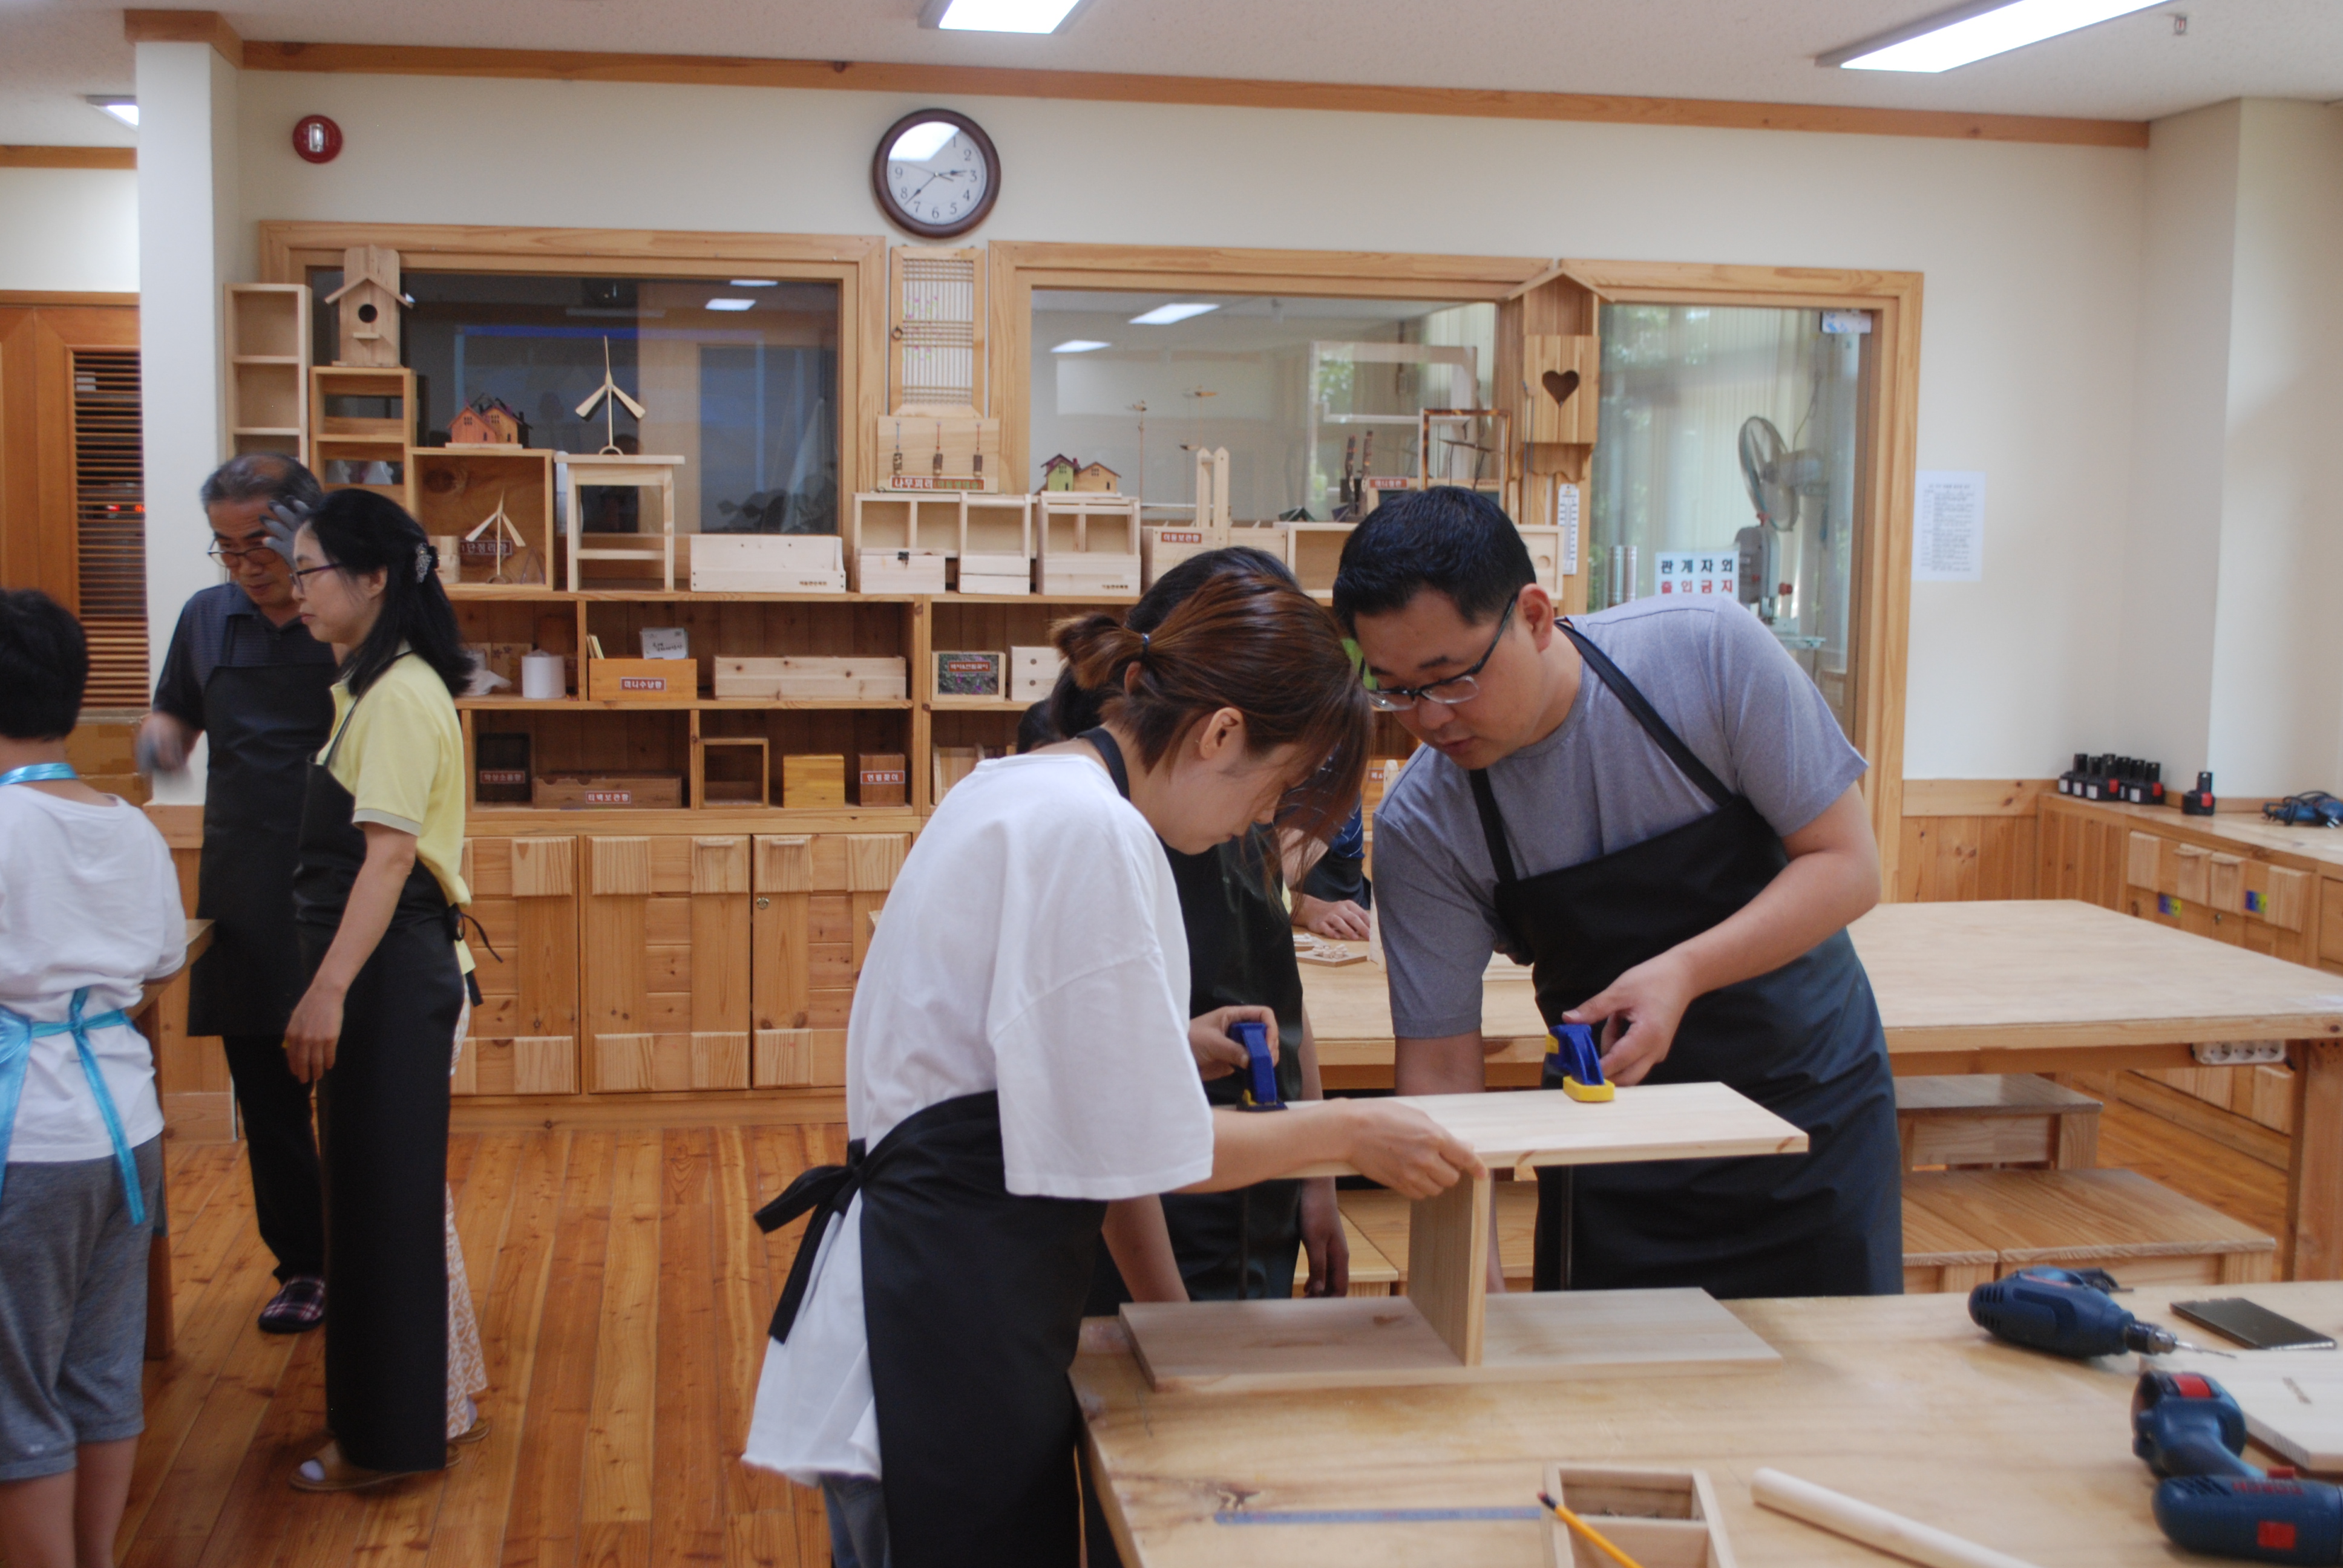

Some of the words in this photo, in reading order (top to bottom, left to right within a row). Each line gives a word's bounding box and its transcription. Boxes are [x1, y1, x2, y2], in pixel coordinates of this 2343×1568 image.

[952, 136, 957, 148] 1
[964, 149, 971, 161] 2
[895, 167, 903, 178] 9
[970, 170, 977, 182] 3
[900, 188, 908, 199] 8
[963, 190, 970, 201] 4
[914, 201, 920, 213] 7
[949, 203, 957, 214] 5
[932, 208, 939, 219] 6
[1662, 559, 1733, 574] 관계자외
[1662, 580, 1733, 594] 출입금지
[867, 773, 899, 782] 연필꽂이
